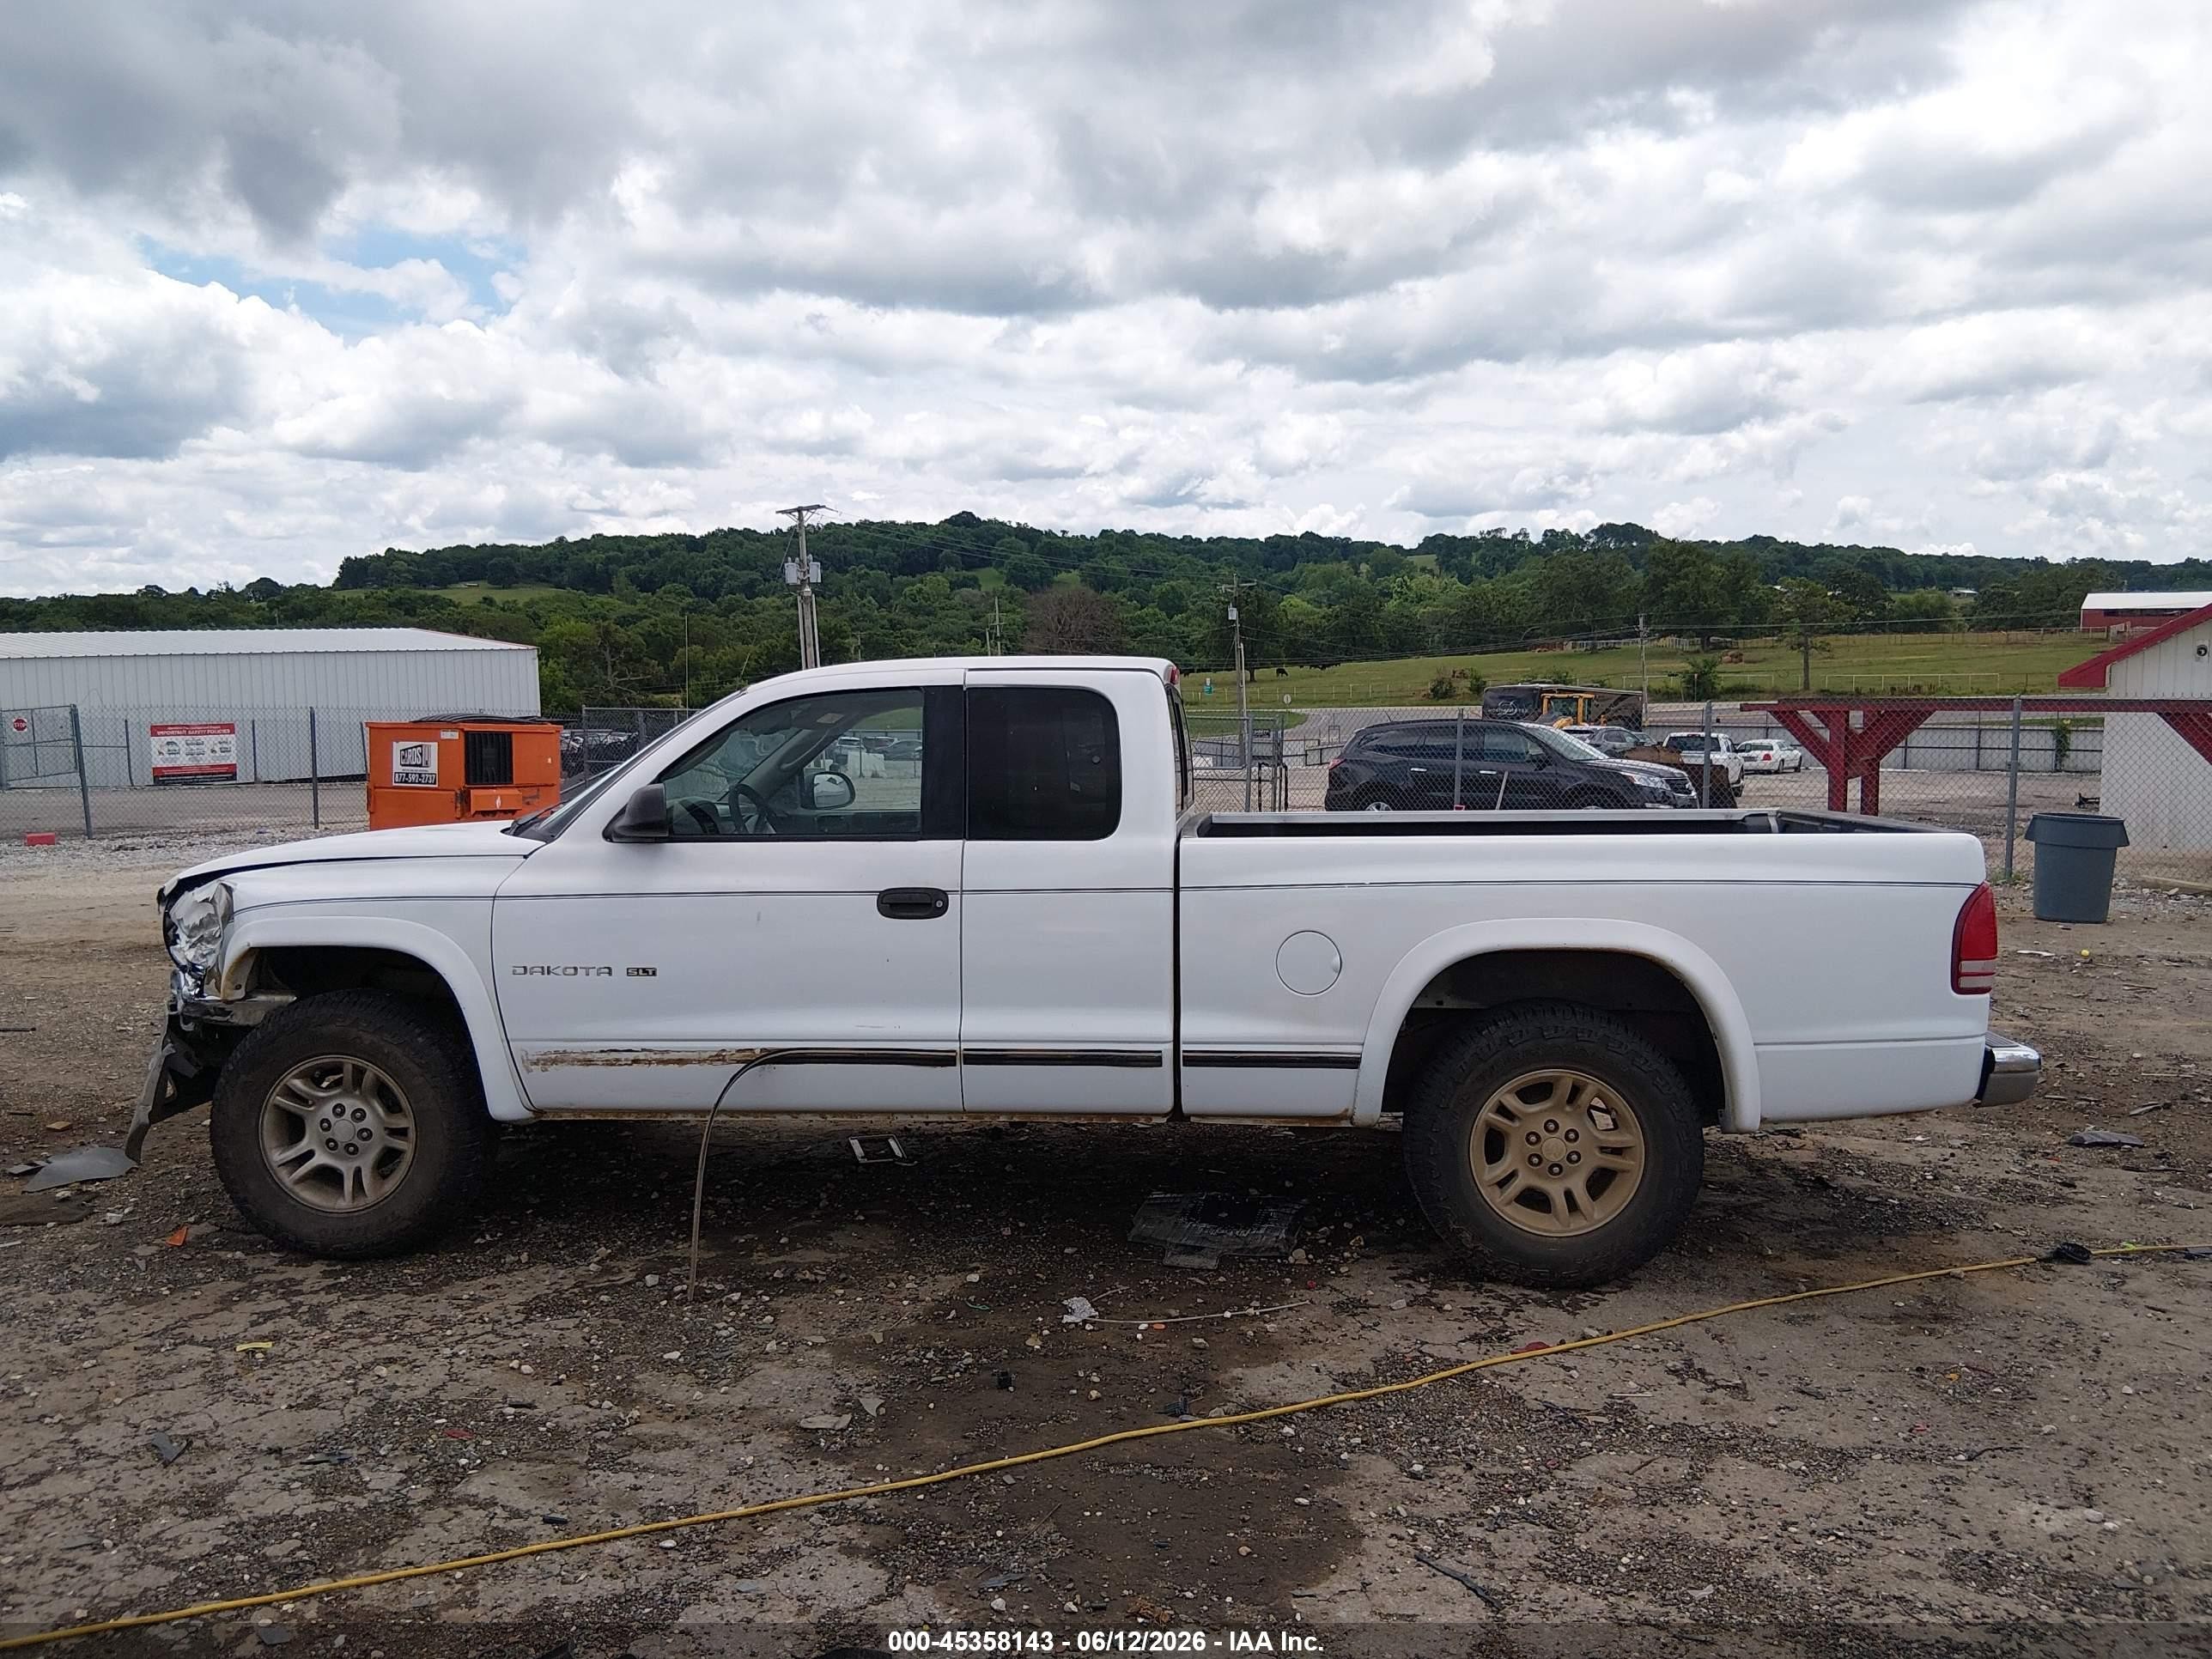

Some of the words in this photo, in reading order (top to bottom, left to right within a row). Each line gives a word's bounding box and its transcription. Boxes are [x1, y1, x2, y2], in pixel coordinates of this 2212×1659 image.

[400, 746, 422, 765] CARDS
[395, 773, 436, 784] 877-592-2737
[513, 966, 613, 976] DAKOTA
[627, 968, 657, 976] SLT
